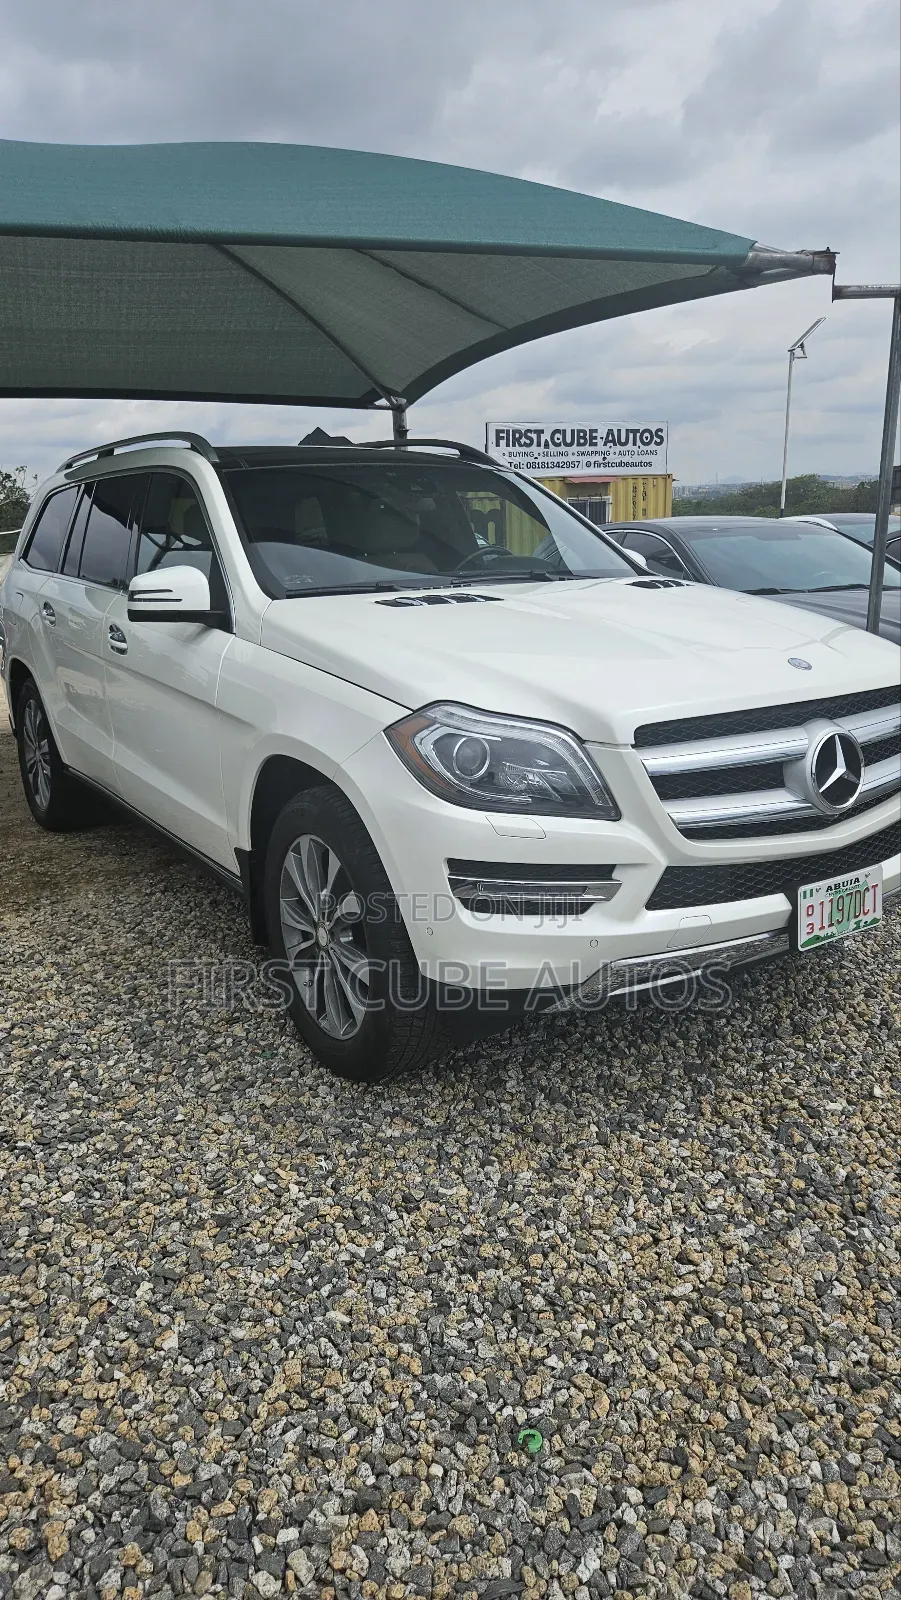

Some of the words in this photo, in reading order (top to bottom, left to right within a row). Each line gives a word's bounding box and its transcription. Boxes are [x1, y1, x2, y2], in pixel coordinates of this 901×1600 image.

[495, 429, 544, 447] FIRST
[550, 429, 598, 447] CUBE
[603, 428, 664, 447] AUTOS
[526, 460, 581, 469] 08181342957
[593, 460, 653, 468] firstcubeautos
[819, 884, 878, 931] 1197DCT
